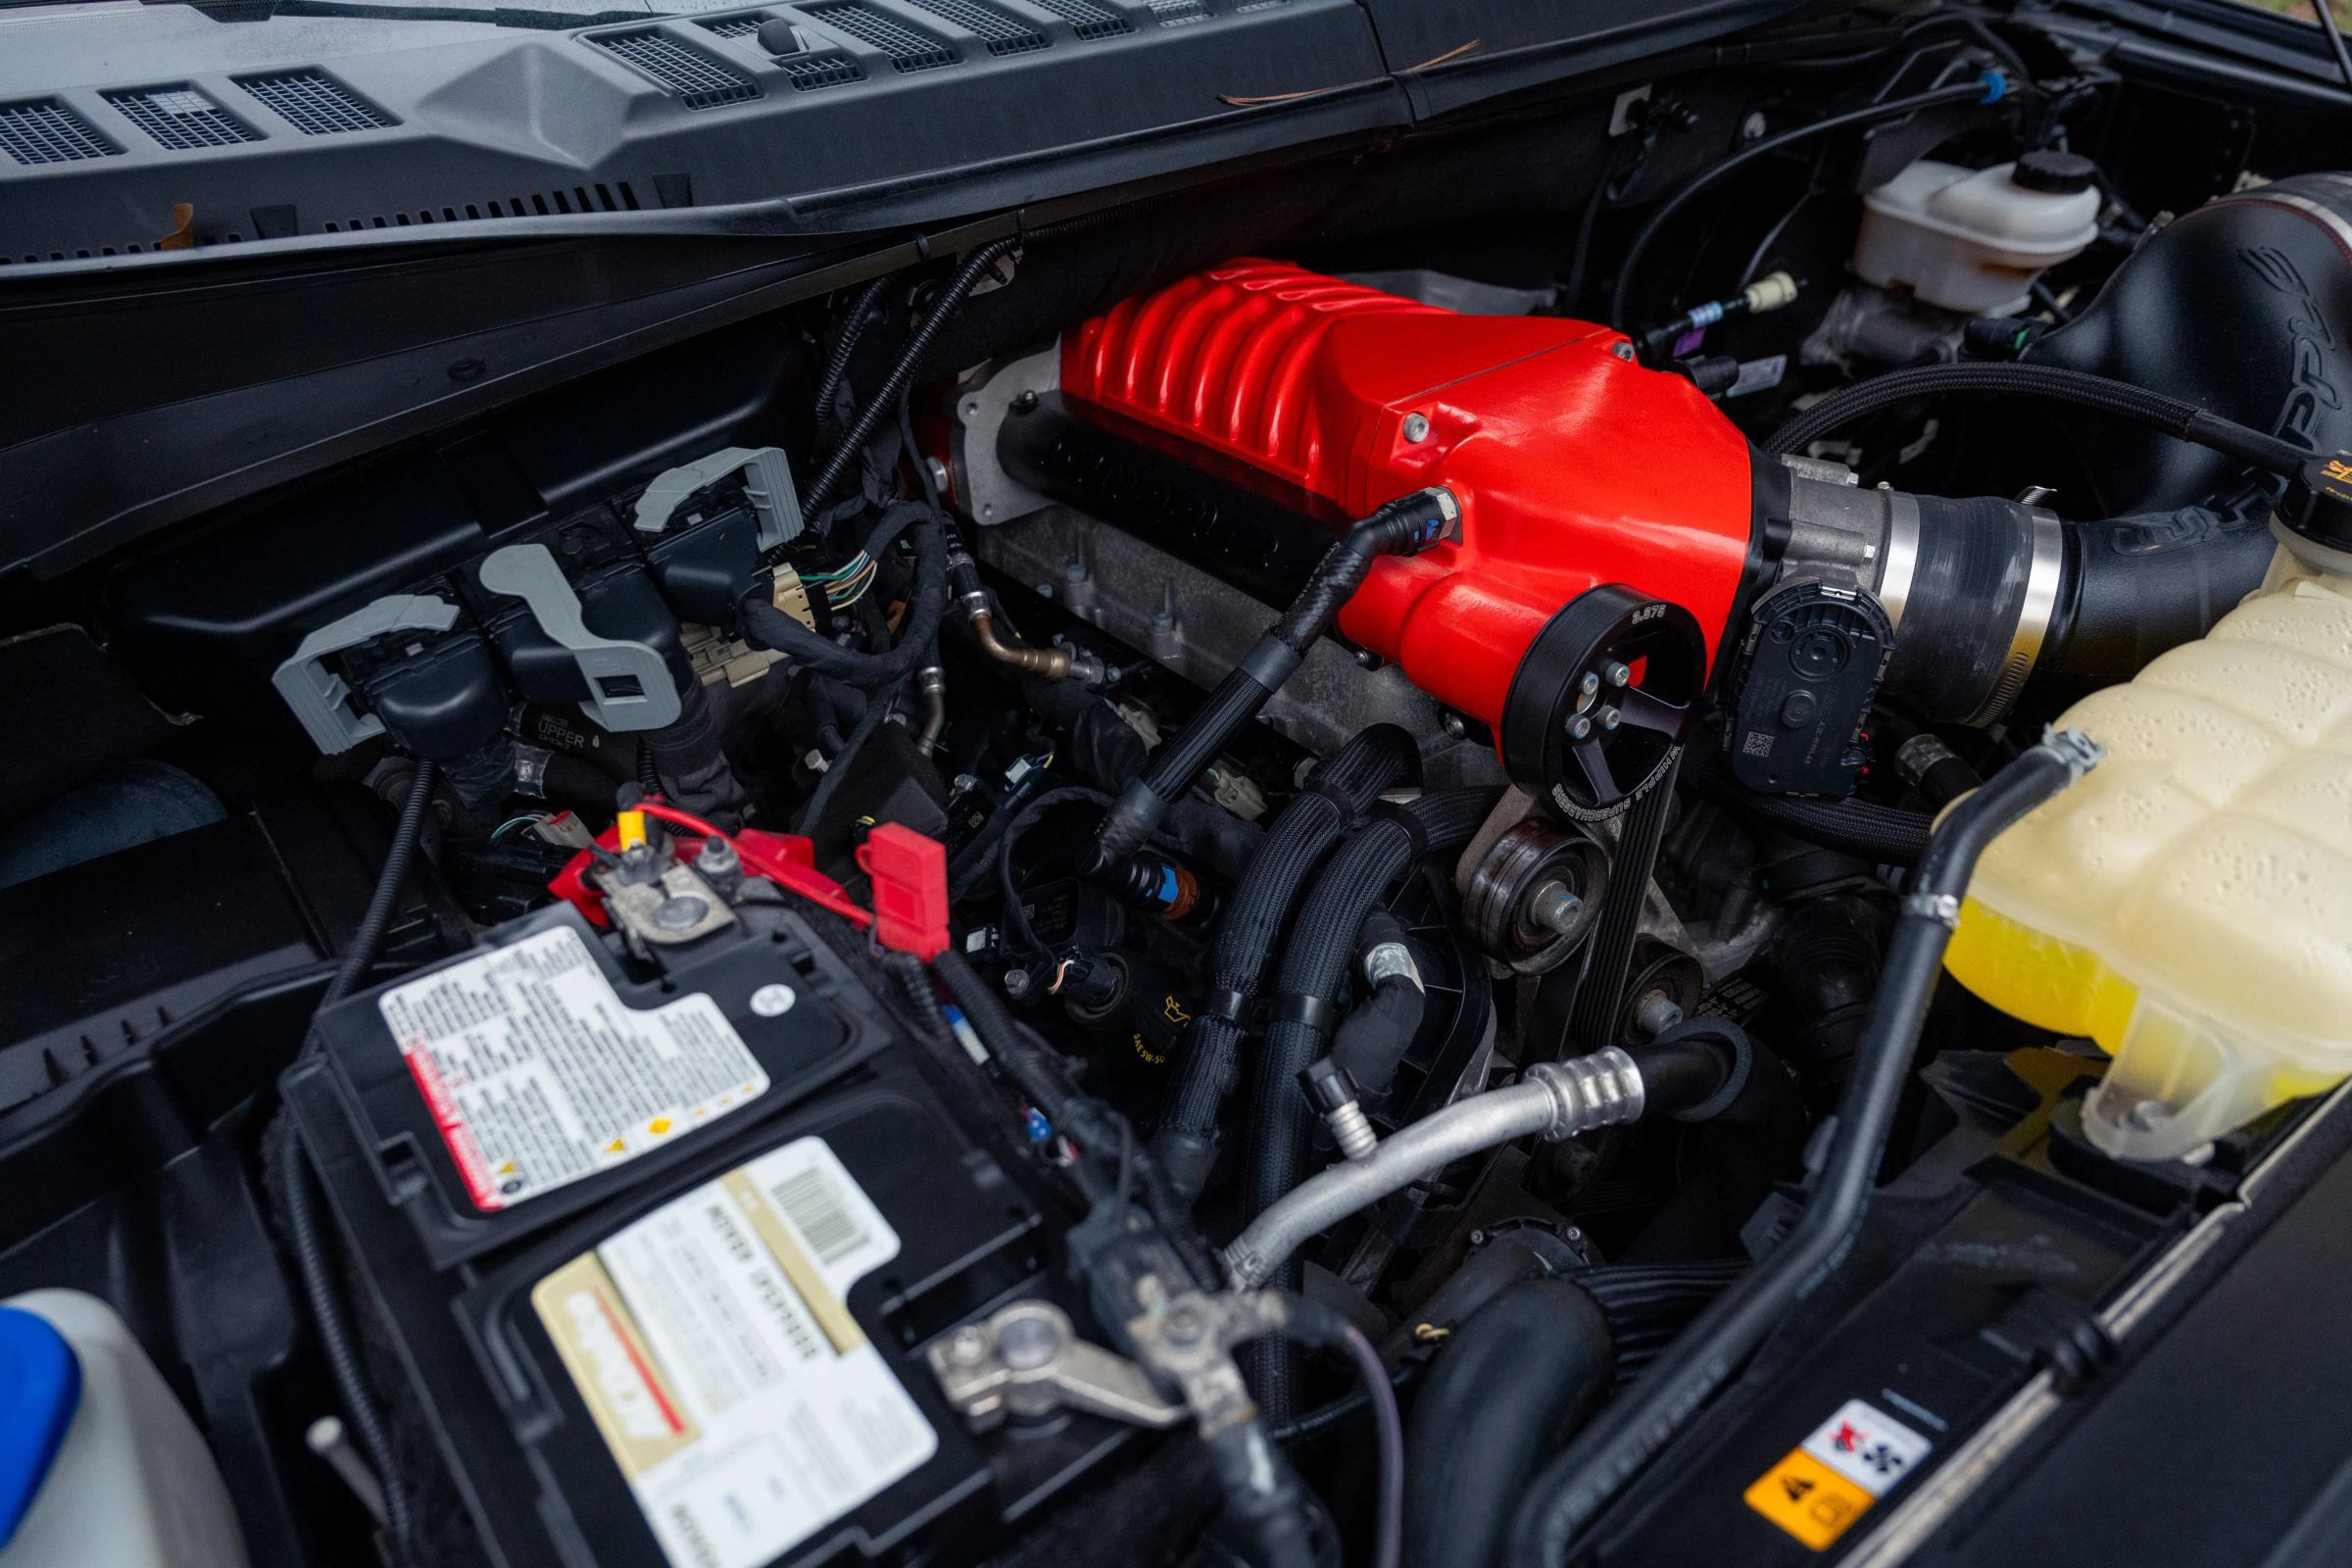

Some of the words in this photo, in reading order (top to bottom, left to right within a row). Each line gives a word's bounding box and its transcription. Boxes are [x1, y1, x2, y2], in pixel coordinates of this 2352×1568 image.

[2110, 245, 2342, 557] WHPPLE
[538, 720, 585, 748] UPPER
[1635, 746, 1681, 802] WHIPPLE
[1551, 783, 1632, 822] SUPERCHARGERS
[1133, 1033, 1144, 1054] SAE
